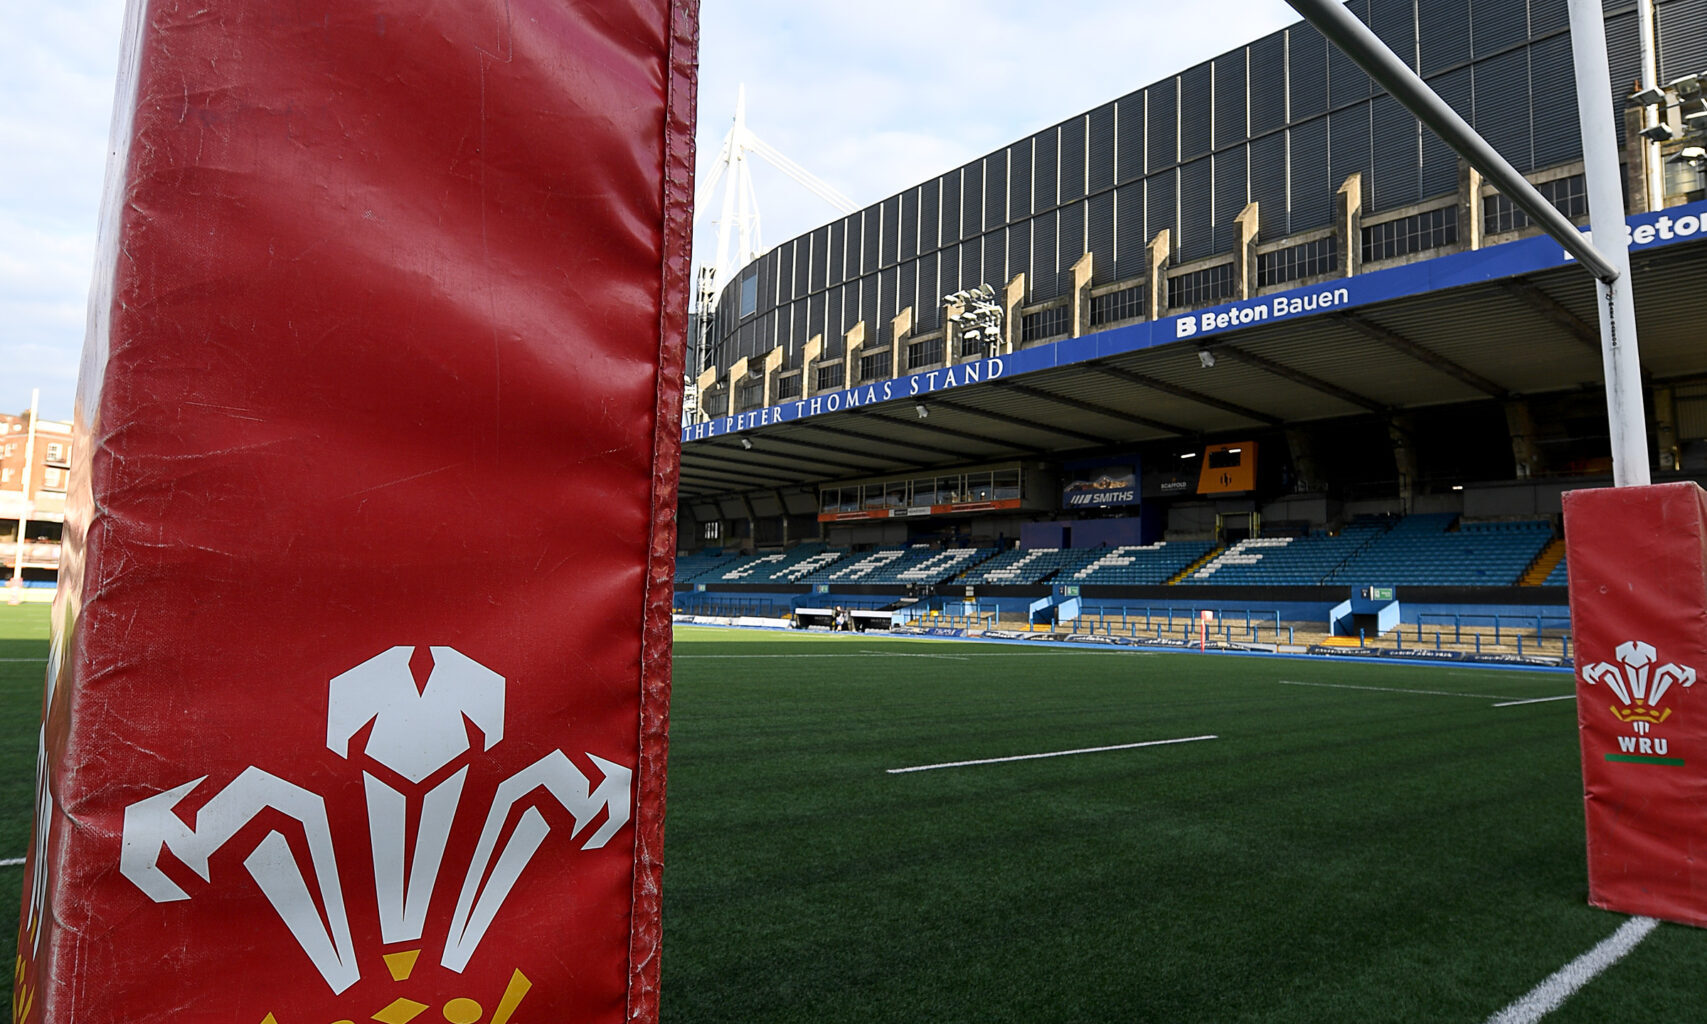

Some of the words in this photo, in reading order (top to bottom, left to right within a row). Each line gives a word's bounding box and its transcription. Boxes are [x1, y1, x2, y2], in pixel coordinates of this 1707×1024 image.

[1625, 212, 1707, 247] eto
[1201, 304, 1268, 332] Beton
[1273, 287, 1349, 317] Bauen
[684, 421, 716, 442] THE
[725, 406, 783, 433] PETER
[795, 381, 892, 420] THOMAS
[910, 358, 1005, 395] STAND
[1093, 491, 1133, 503] SMITHS
[1617, 736, 1668, 755] WRU
